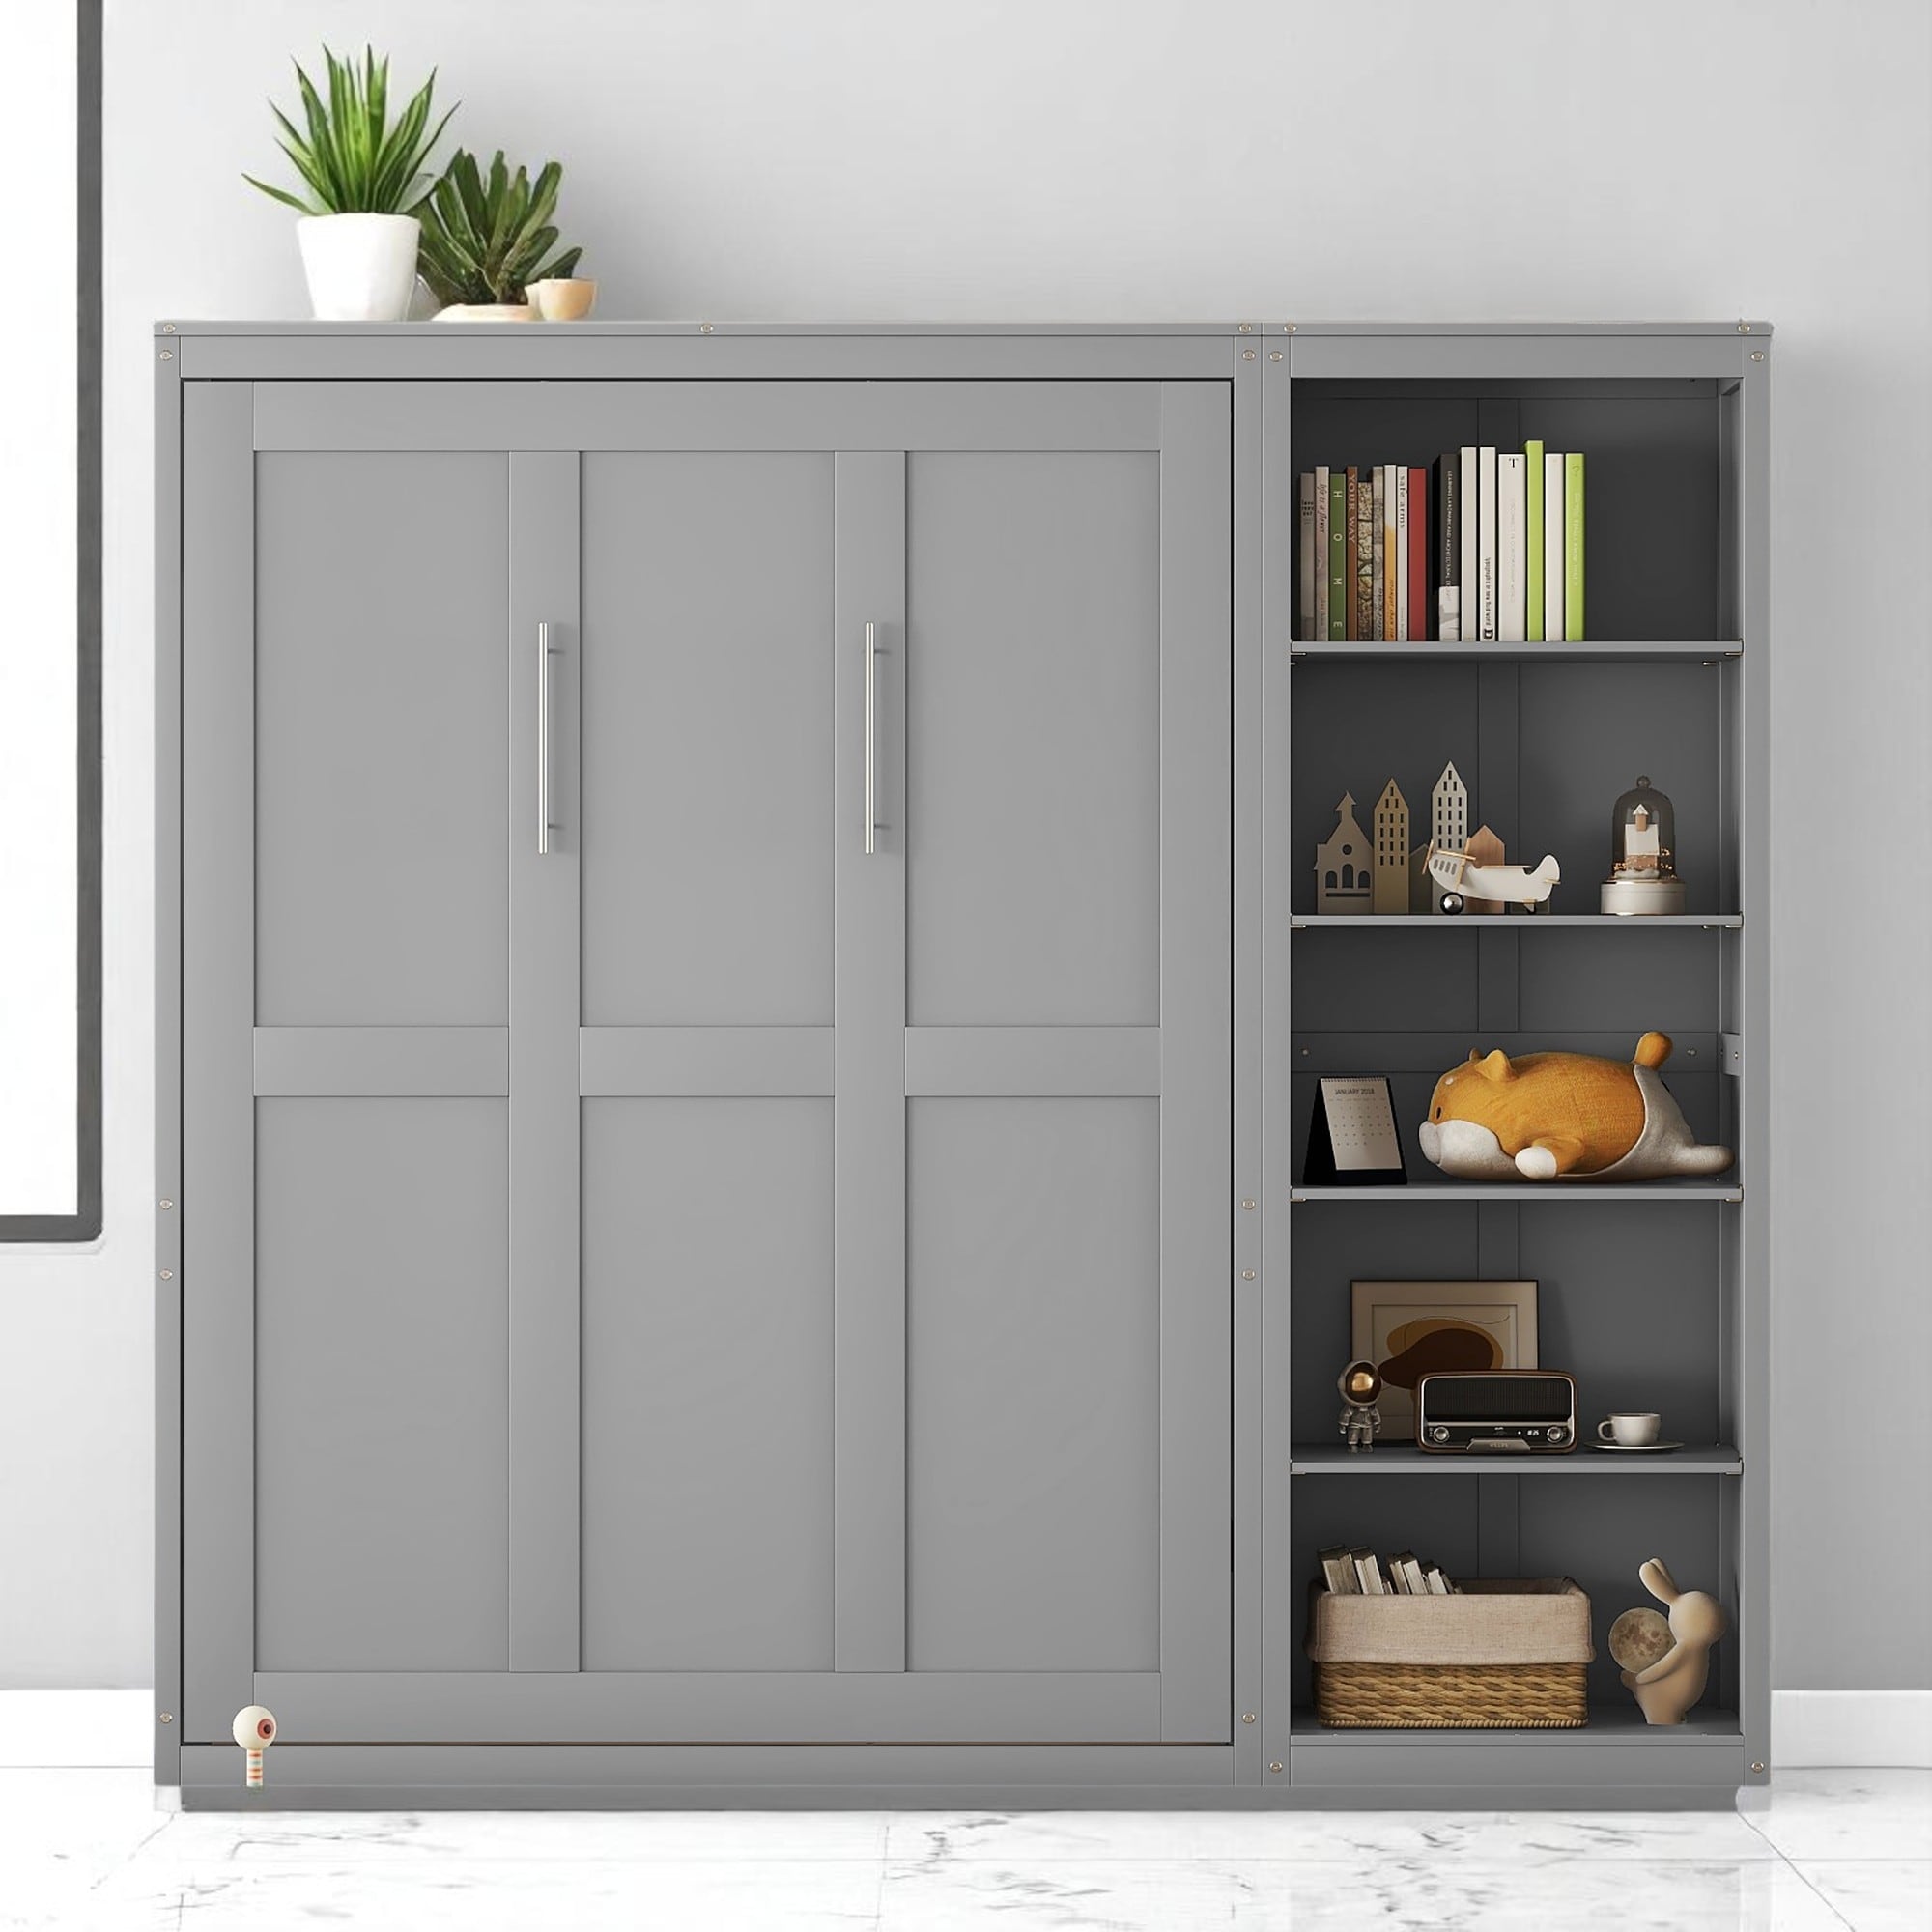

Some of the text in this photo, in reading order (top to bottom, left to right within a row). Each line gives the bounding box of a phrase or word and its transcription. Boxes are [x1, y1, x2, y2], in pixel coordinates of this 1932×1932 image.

[1508, 457, 1519, 469] T
[1399, 475, 1408, 498] safe
[1483, 628, 1494, 640] D
